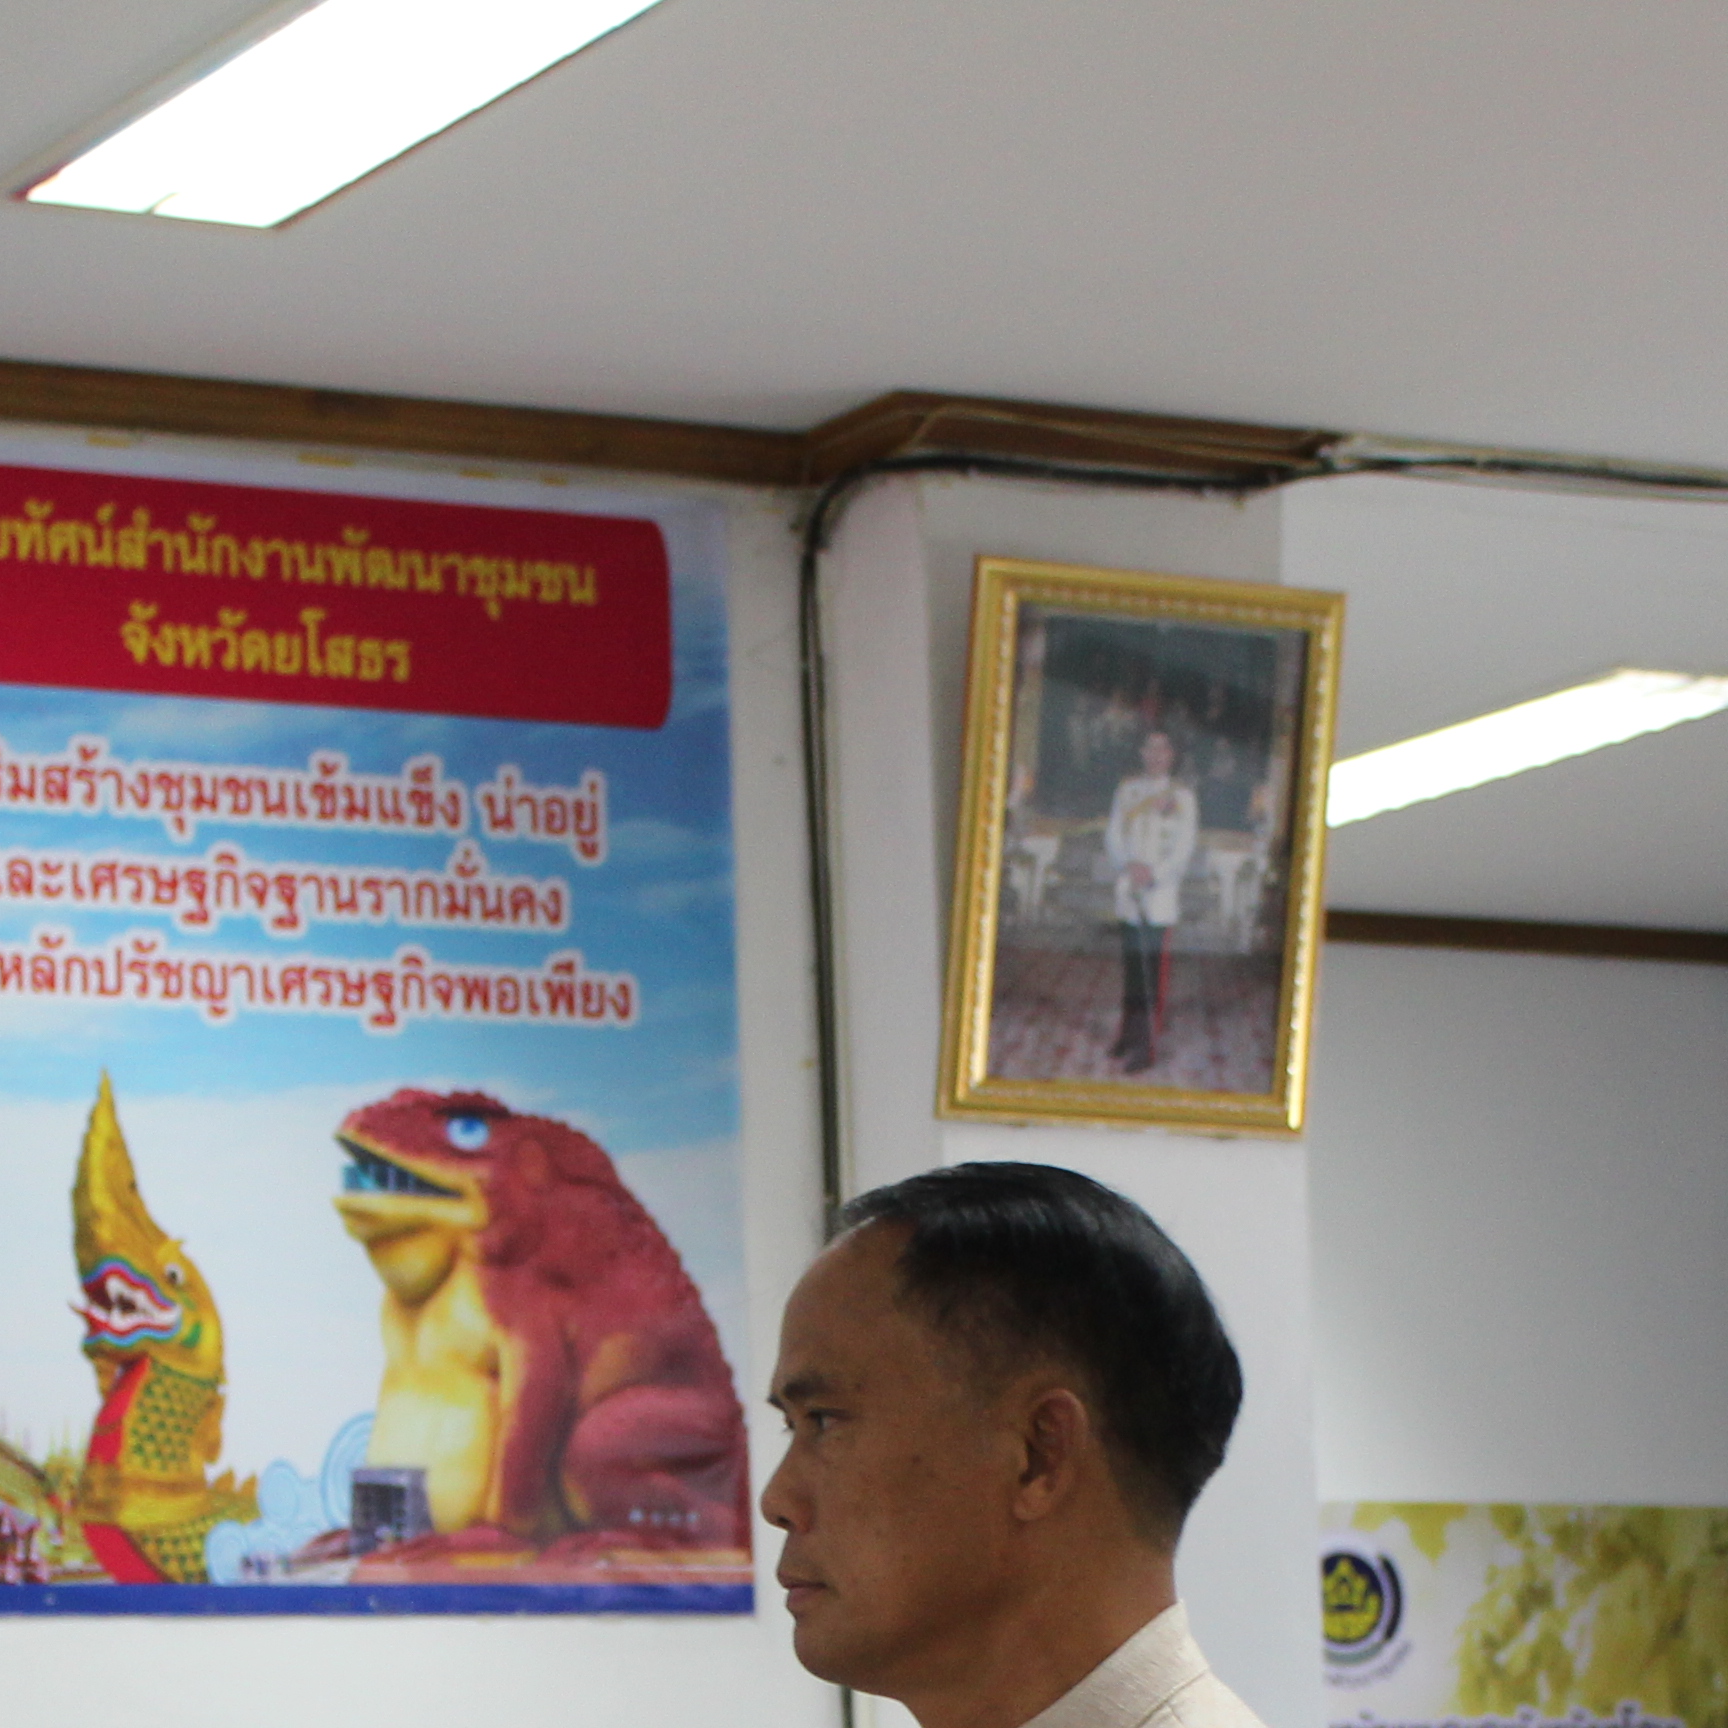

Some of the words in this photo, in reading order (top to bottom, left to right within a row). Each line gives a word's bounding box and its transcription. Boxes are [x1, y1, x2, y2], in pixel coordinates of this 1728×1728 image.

[119, 602, 412, 684] จังหวัดยโสธร
[480, 770, 603, 858] น่าอยู่
